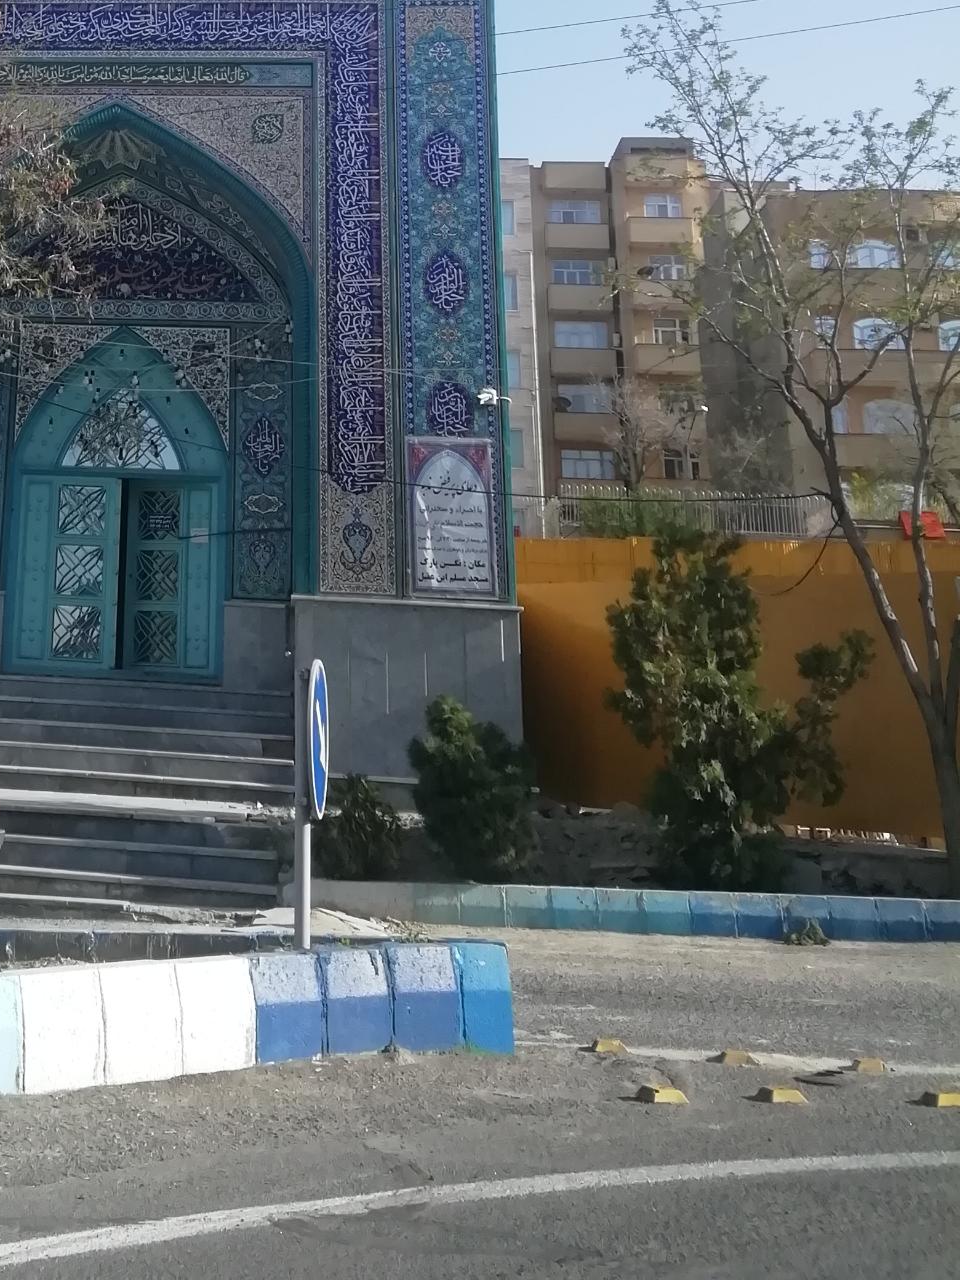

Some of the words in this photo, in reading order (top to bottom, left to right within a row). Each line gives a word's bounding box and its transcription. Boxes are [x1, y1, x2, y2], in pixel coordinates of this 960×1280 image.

[467, 560, 486, 570] مکان
[449, 573, 467, 584] مسلم
[467, 575, 489, 584] مسجد
